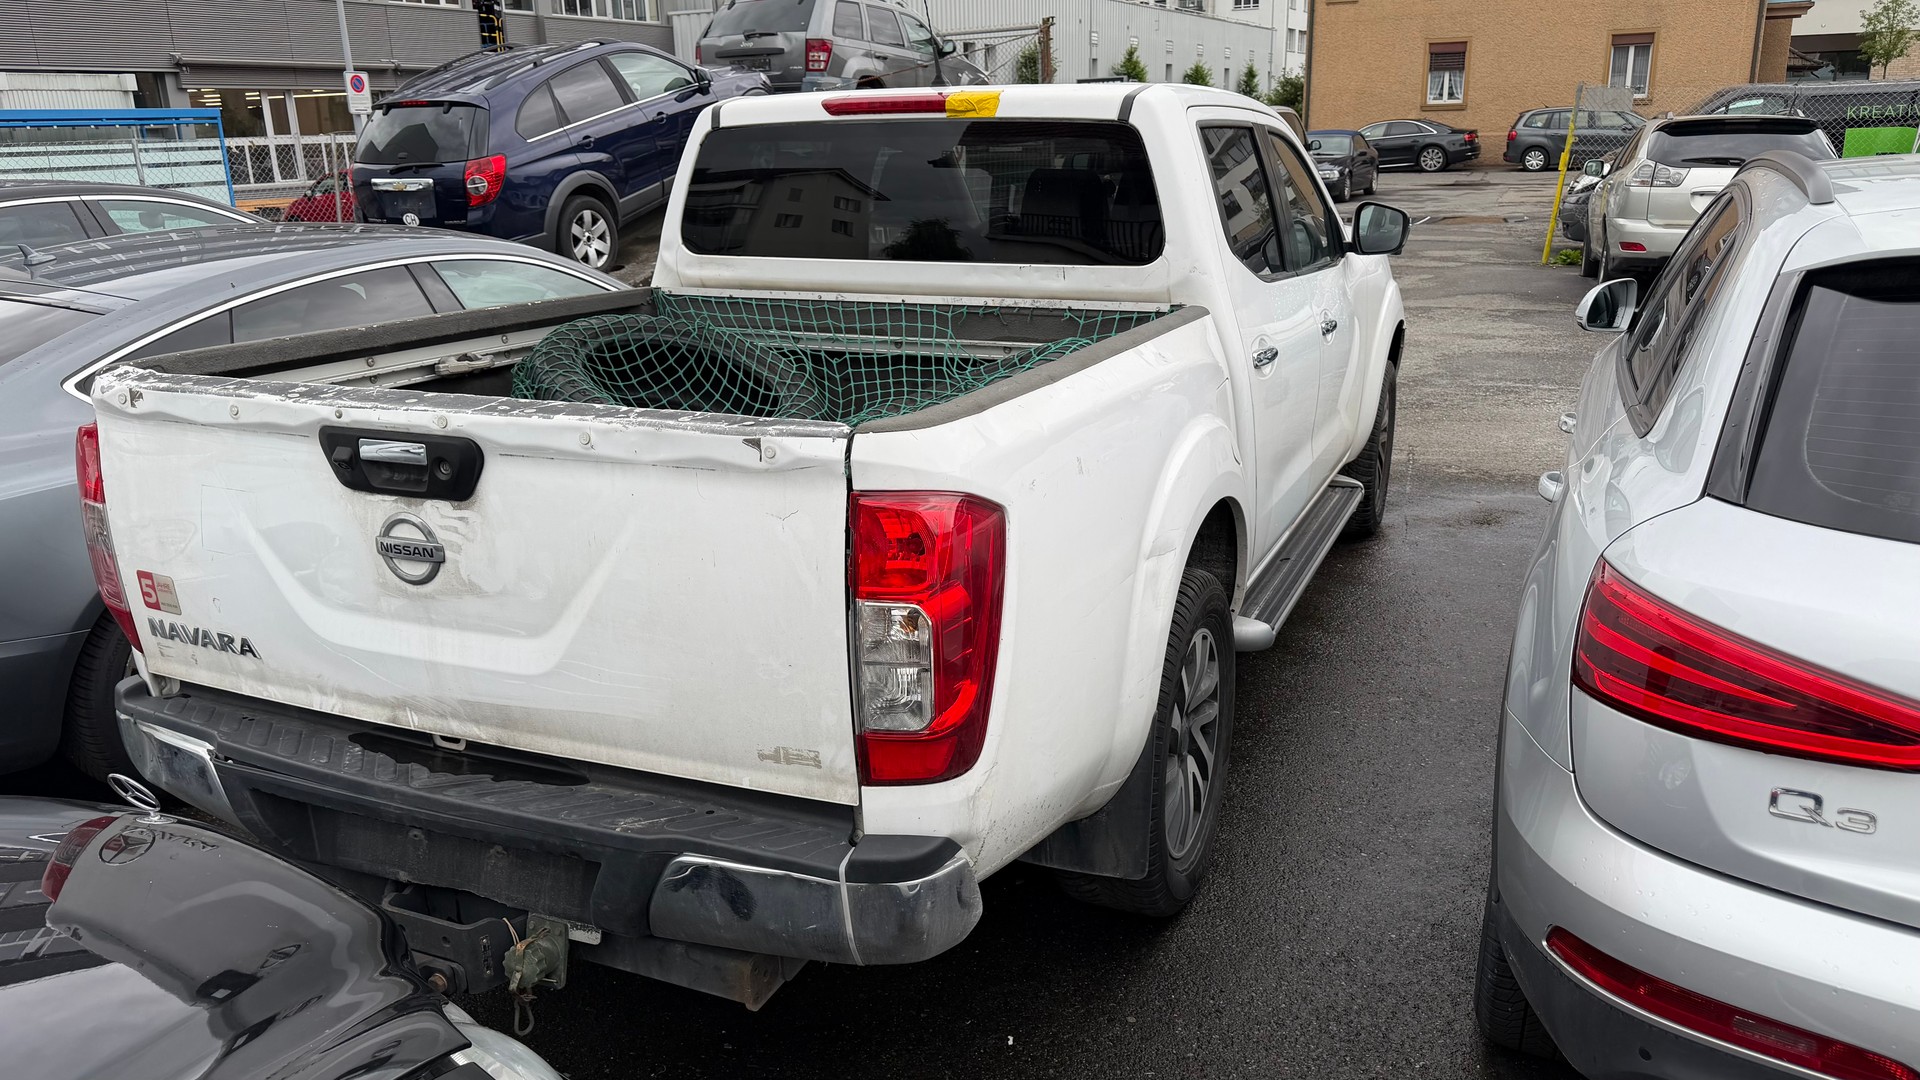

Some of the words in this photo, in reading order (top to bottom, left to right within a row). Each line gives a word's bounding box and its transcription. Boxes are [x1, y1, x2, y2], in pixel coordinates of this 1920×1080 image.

[379, 541, 434, 558] NISSAN
[141, 578, 157, 604] 5
[147, 615, 263, 661] NAVARA
[1768, 786, 1877, 835] Q3
